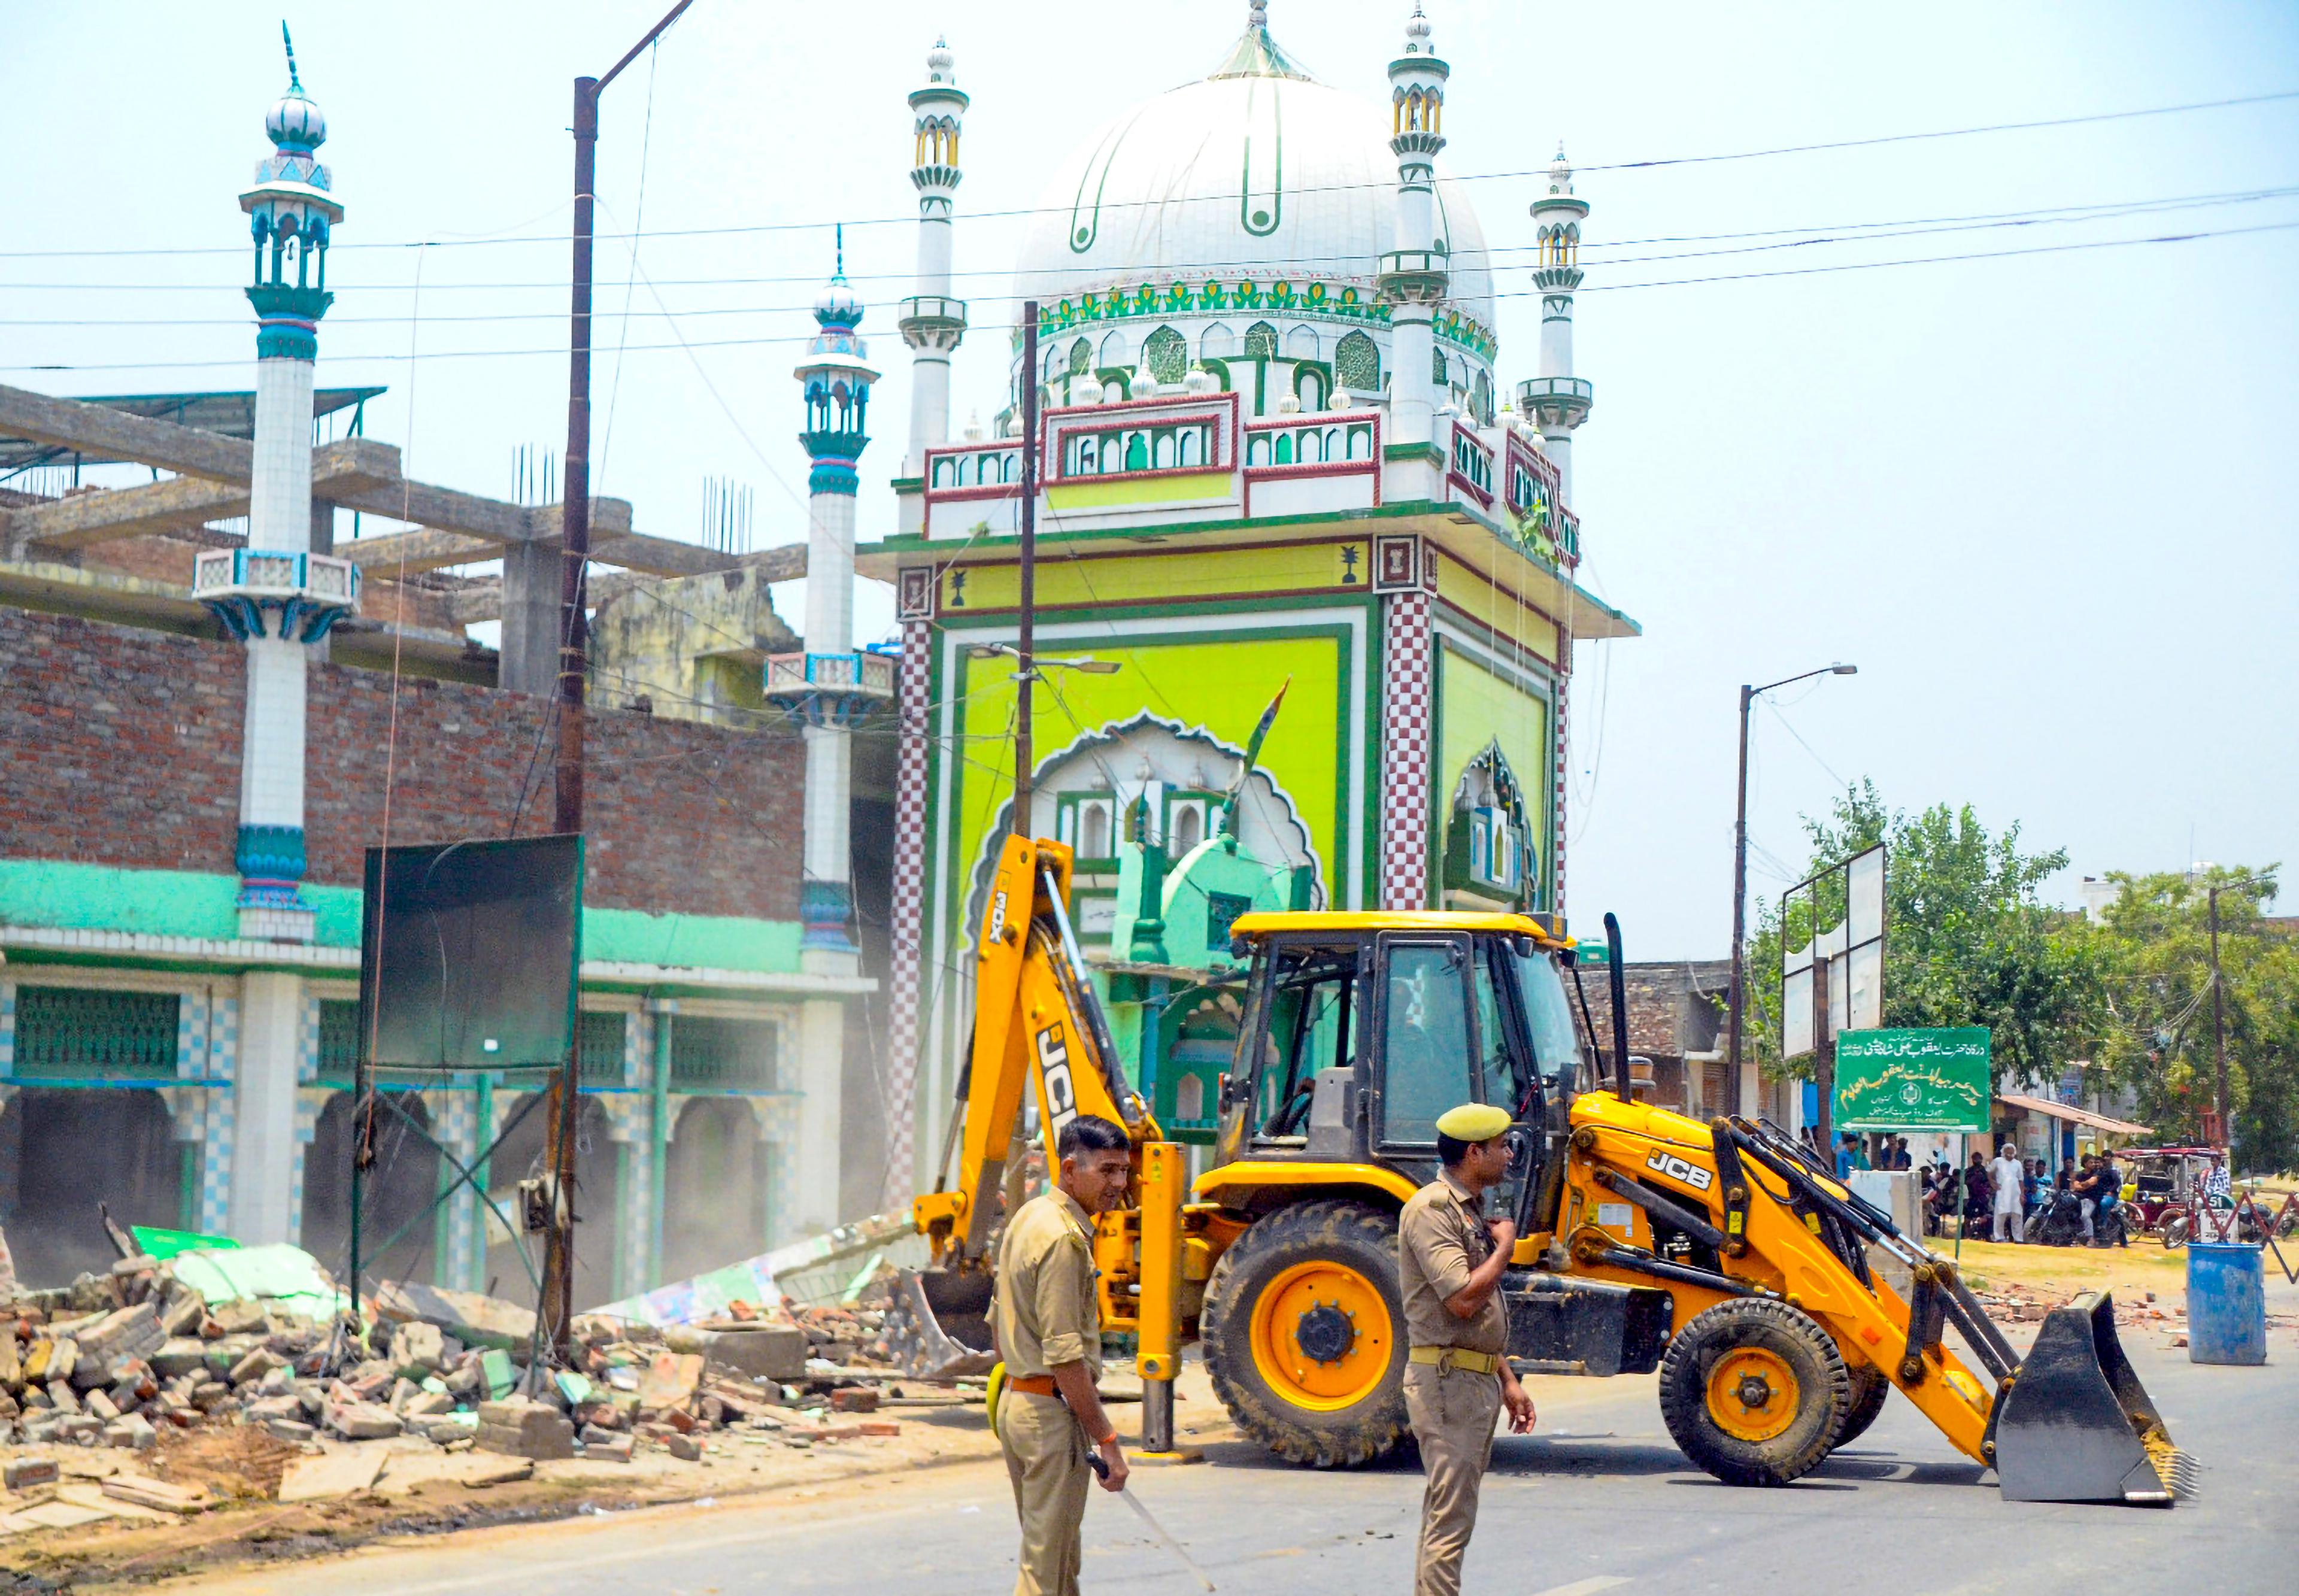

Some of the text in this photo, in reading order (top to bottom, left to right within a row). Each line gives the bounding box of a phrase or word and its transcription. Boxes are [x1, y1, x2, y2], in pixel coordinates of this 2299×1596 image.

[990, 891, 1007, 942] 3DX
[1648, 1154, 1712, 1190] JCB
[2208, 1196, 2222, 1207] 51
